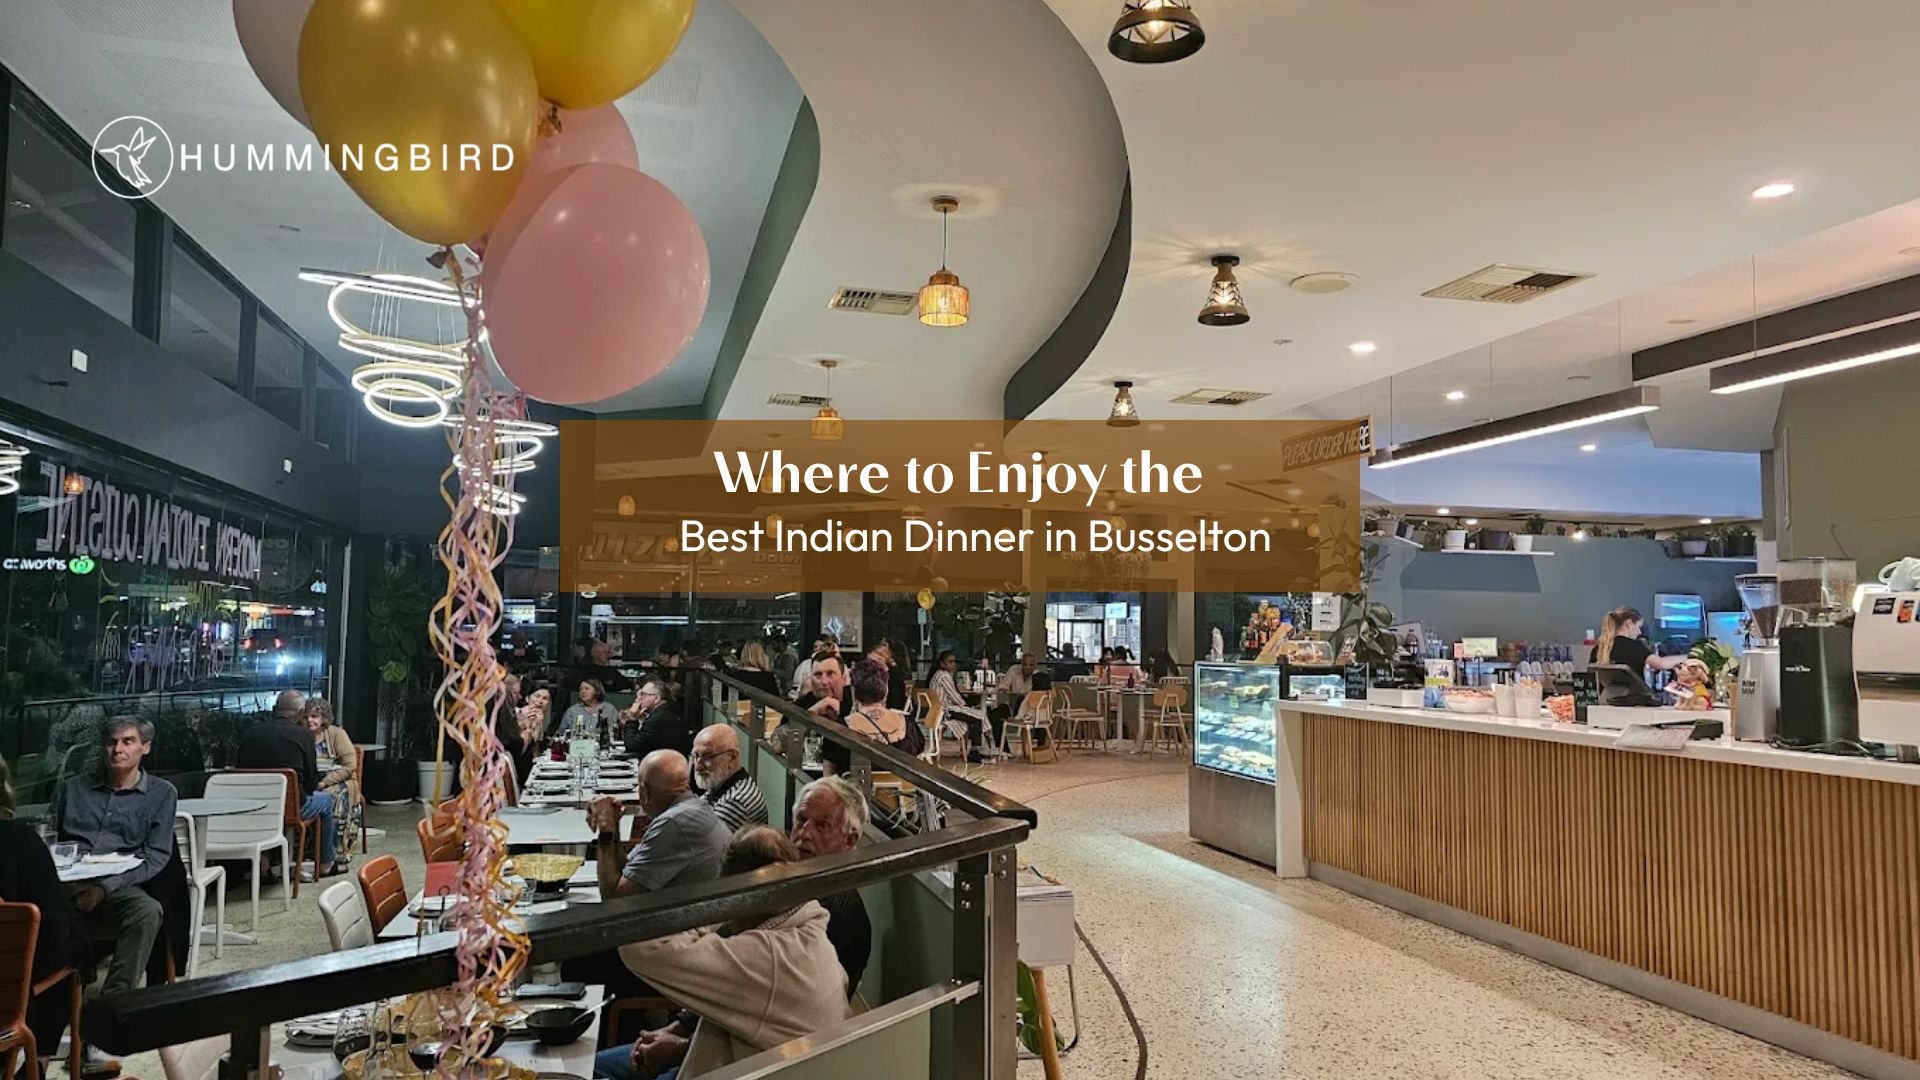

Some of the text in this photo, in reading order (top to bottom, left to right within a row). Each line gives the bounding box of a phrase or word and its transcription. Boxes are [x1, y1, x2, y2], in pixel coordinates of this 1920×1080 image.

[1284, 425, 1371, 467] PLEASE ORDER HERE
